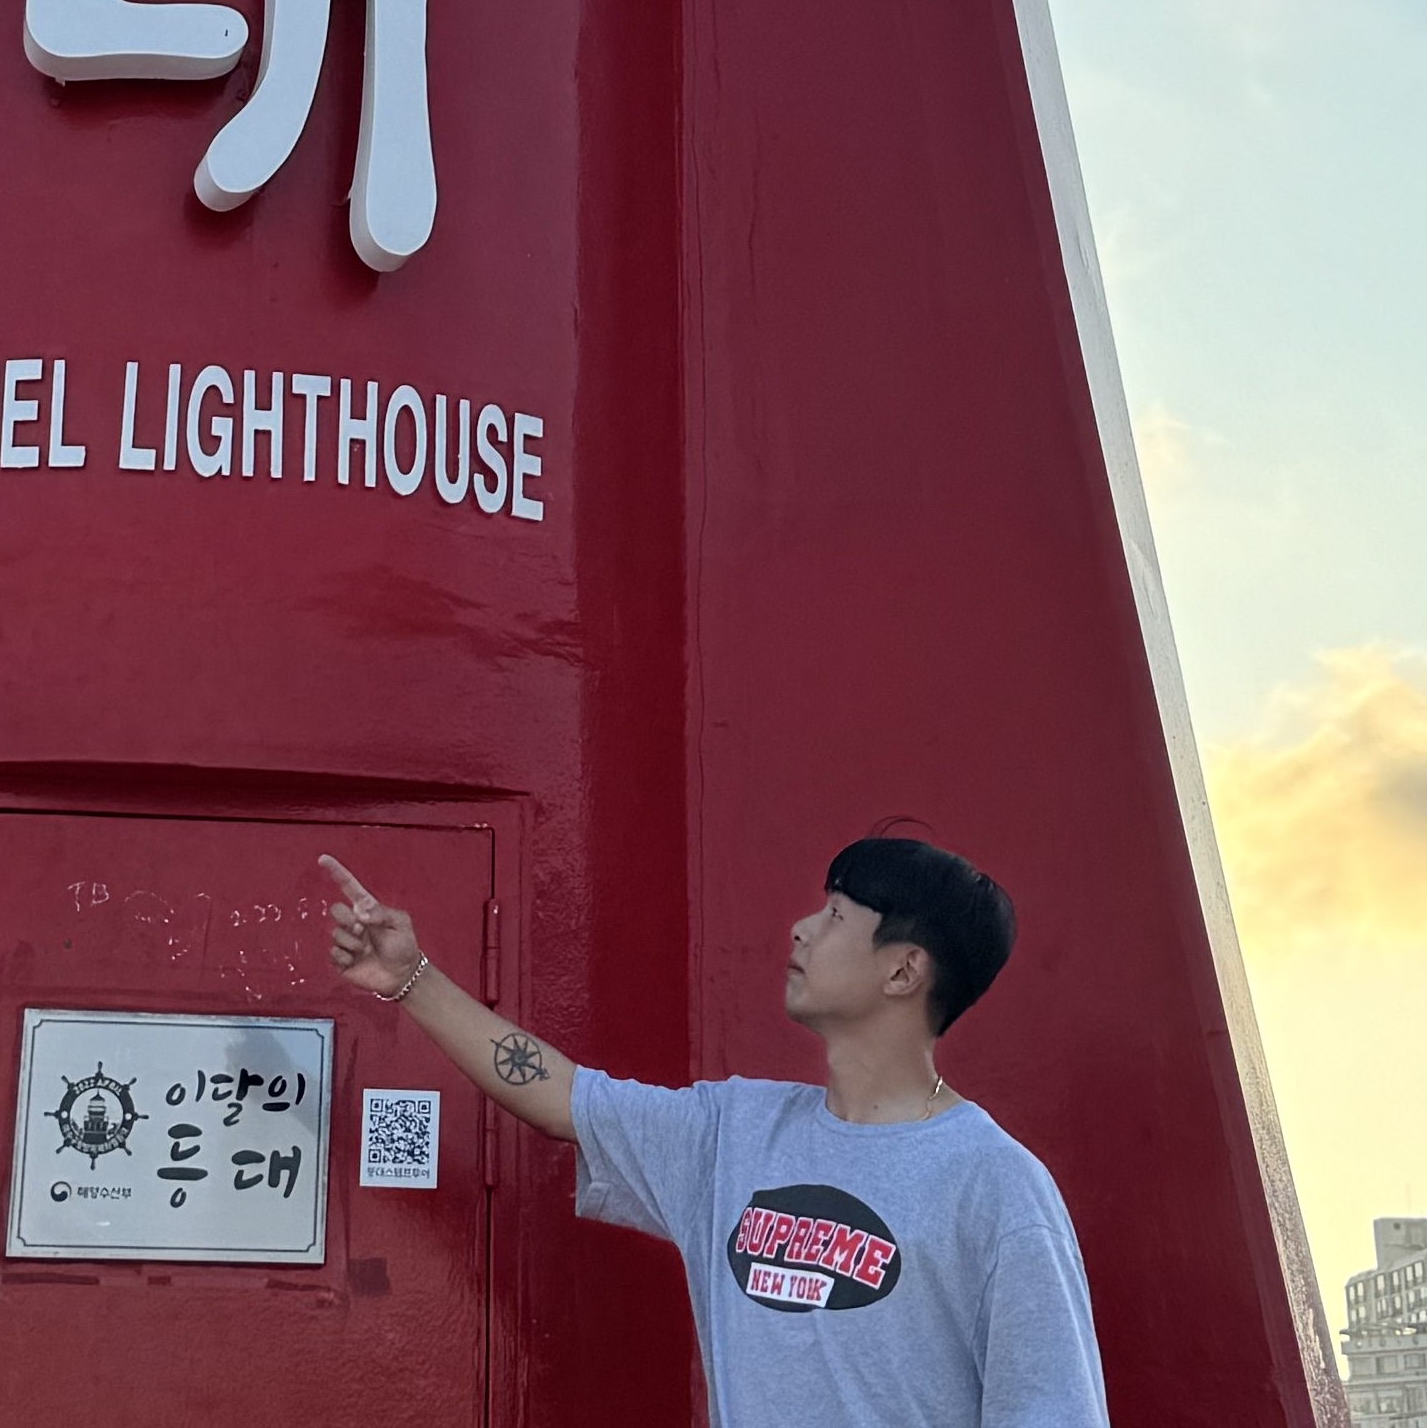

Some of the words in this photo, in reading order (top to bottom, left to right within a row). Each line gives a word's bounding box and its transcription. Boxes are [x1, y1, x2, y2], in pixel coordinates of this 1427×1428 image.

[118, 361, 545, 522] LIGHTHOUSE
[166, 1068, 306, 1126] 이달의
[735, 1207, 897, 1290] SUPREME
[751, 1269, 786, 1296] NEW
[789, 1275, 828, 1301] YORK
